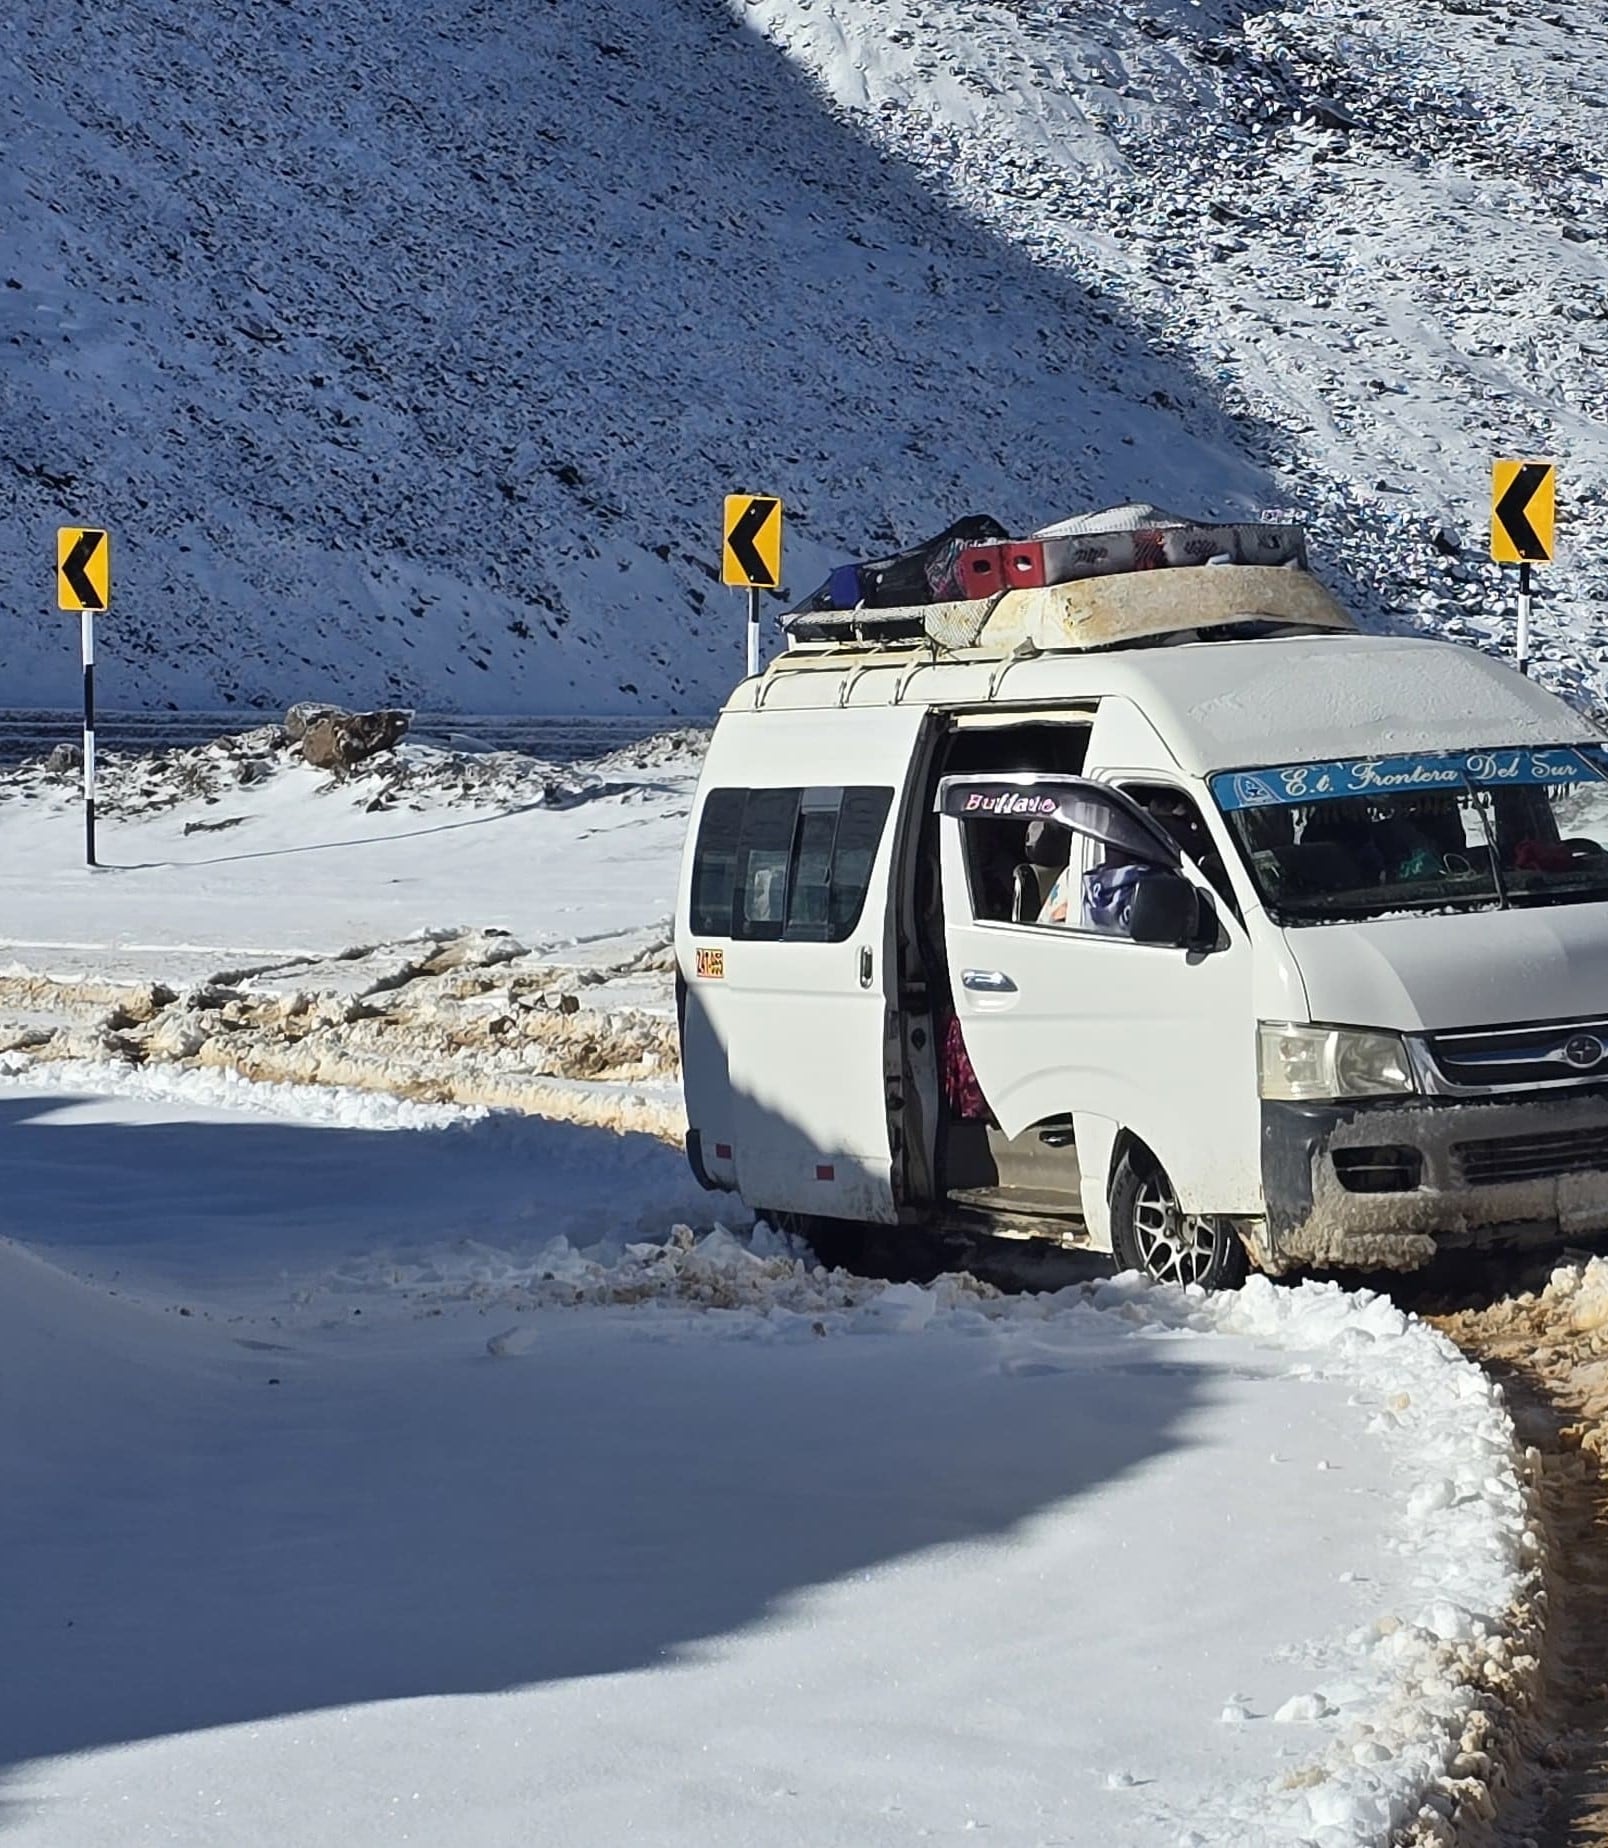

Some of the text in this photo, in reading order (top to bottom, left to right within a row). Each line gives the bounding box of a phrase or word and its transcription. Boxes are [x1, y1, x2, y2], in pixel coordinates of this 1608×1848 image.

[1347, 761, 1458, 790] Frontera
[1466, 754, 1519, 780] Del
[1531, 754, 1577, 778] Sur
